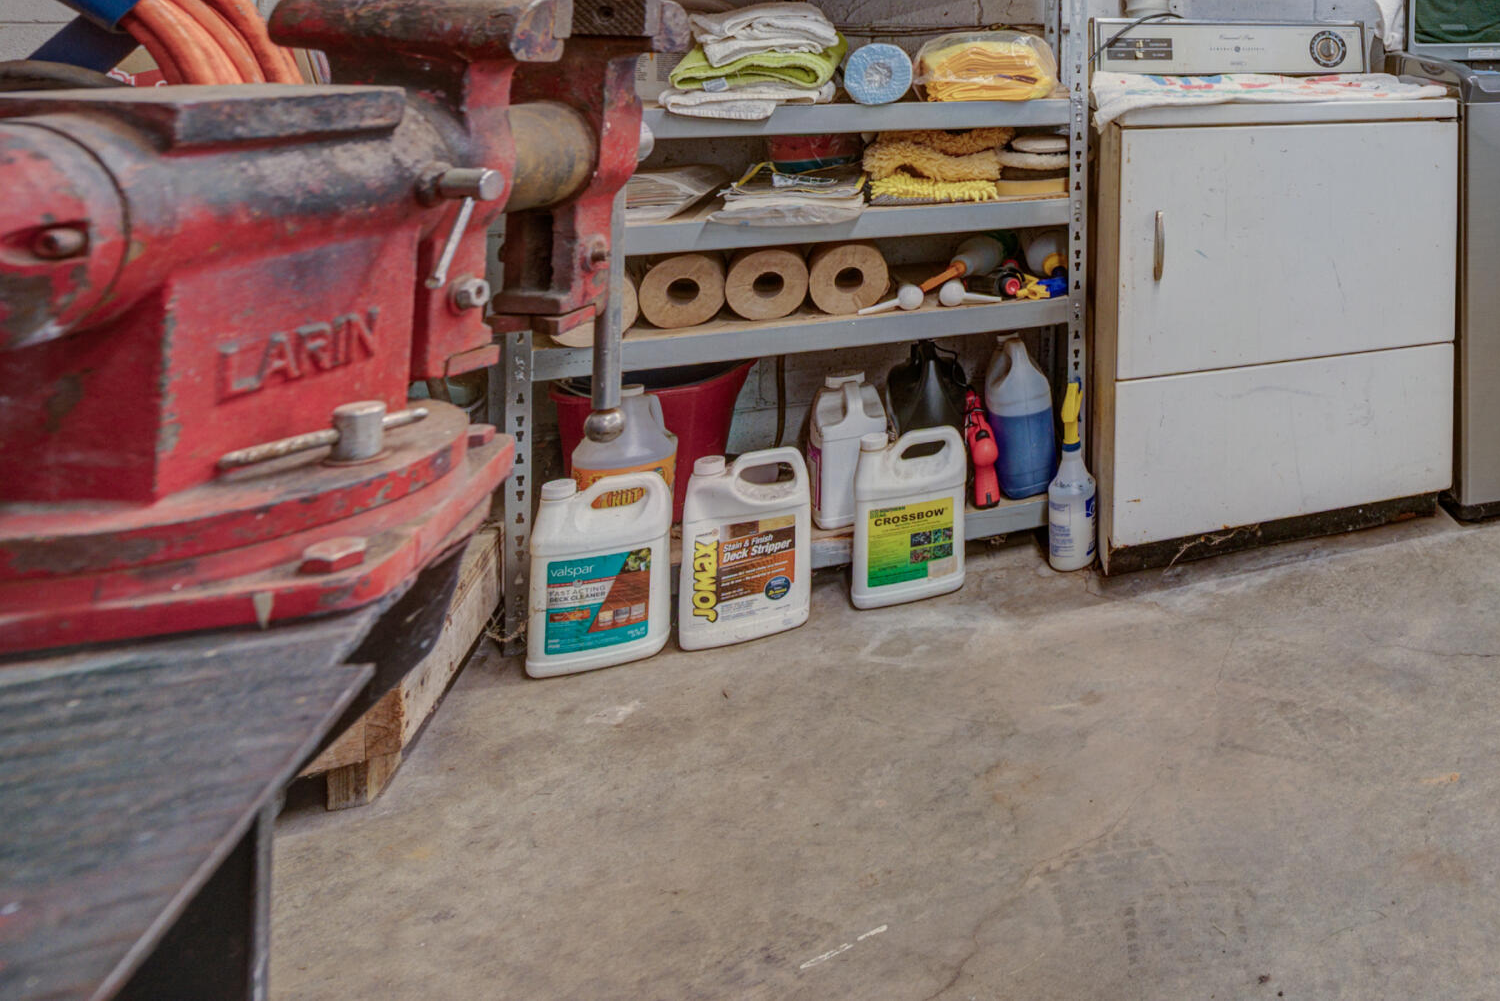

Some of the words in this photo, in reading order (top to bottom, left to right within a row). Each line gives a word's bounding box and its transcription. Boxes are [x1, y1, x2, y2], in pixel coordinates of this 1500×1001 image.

[216, 305, 381, 405] LARIN
[874, 507, 945, 527] CROSSBOW
[722, 542, 743, 553] Stain
[751, 534, 774, 546] Finish
[722, 548, 749, 563] Deck
[750, 539, 792, 556] Stripper
[550, 564, 595, 578] valspar
[692, 540, 719, 623] JOMAX
